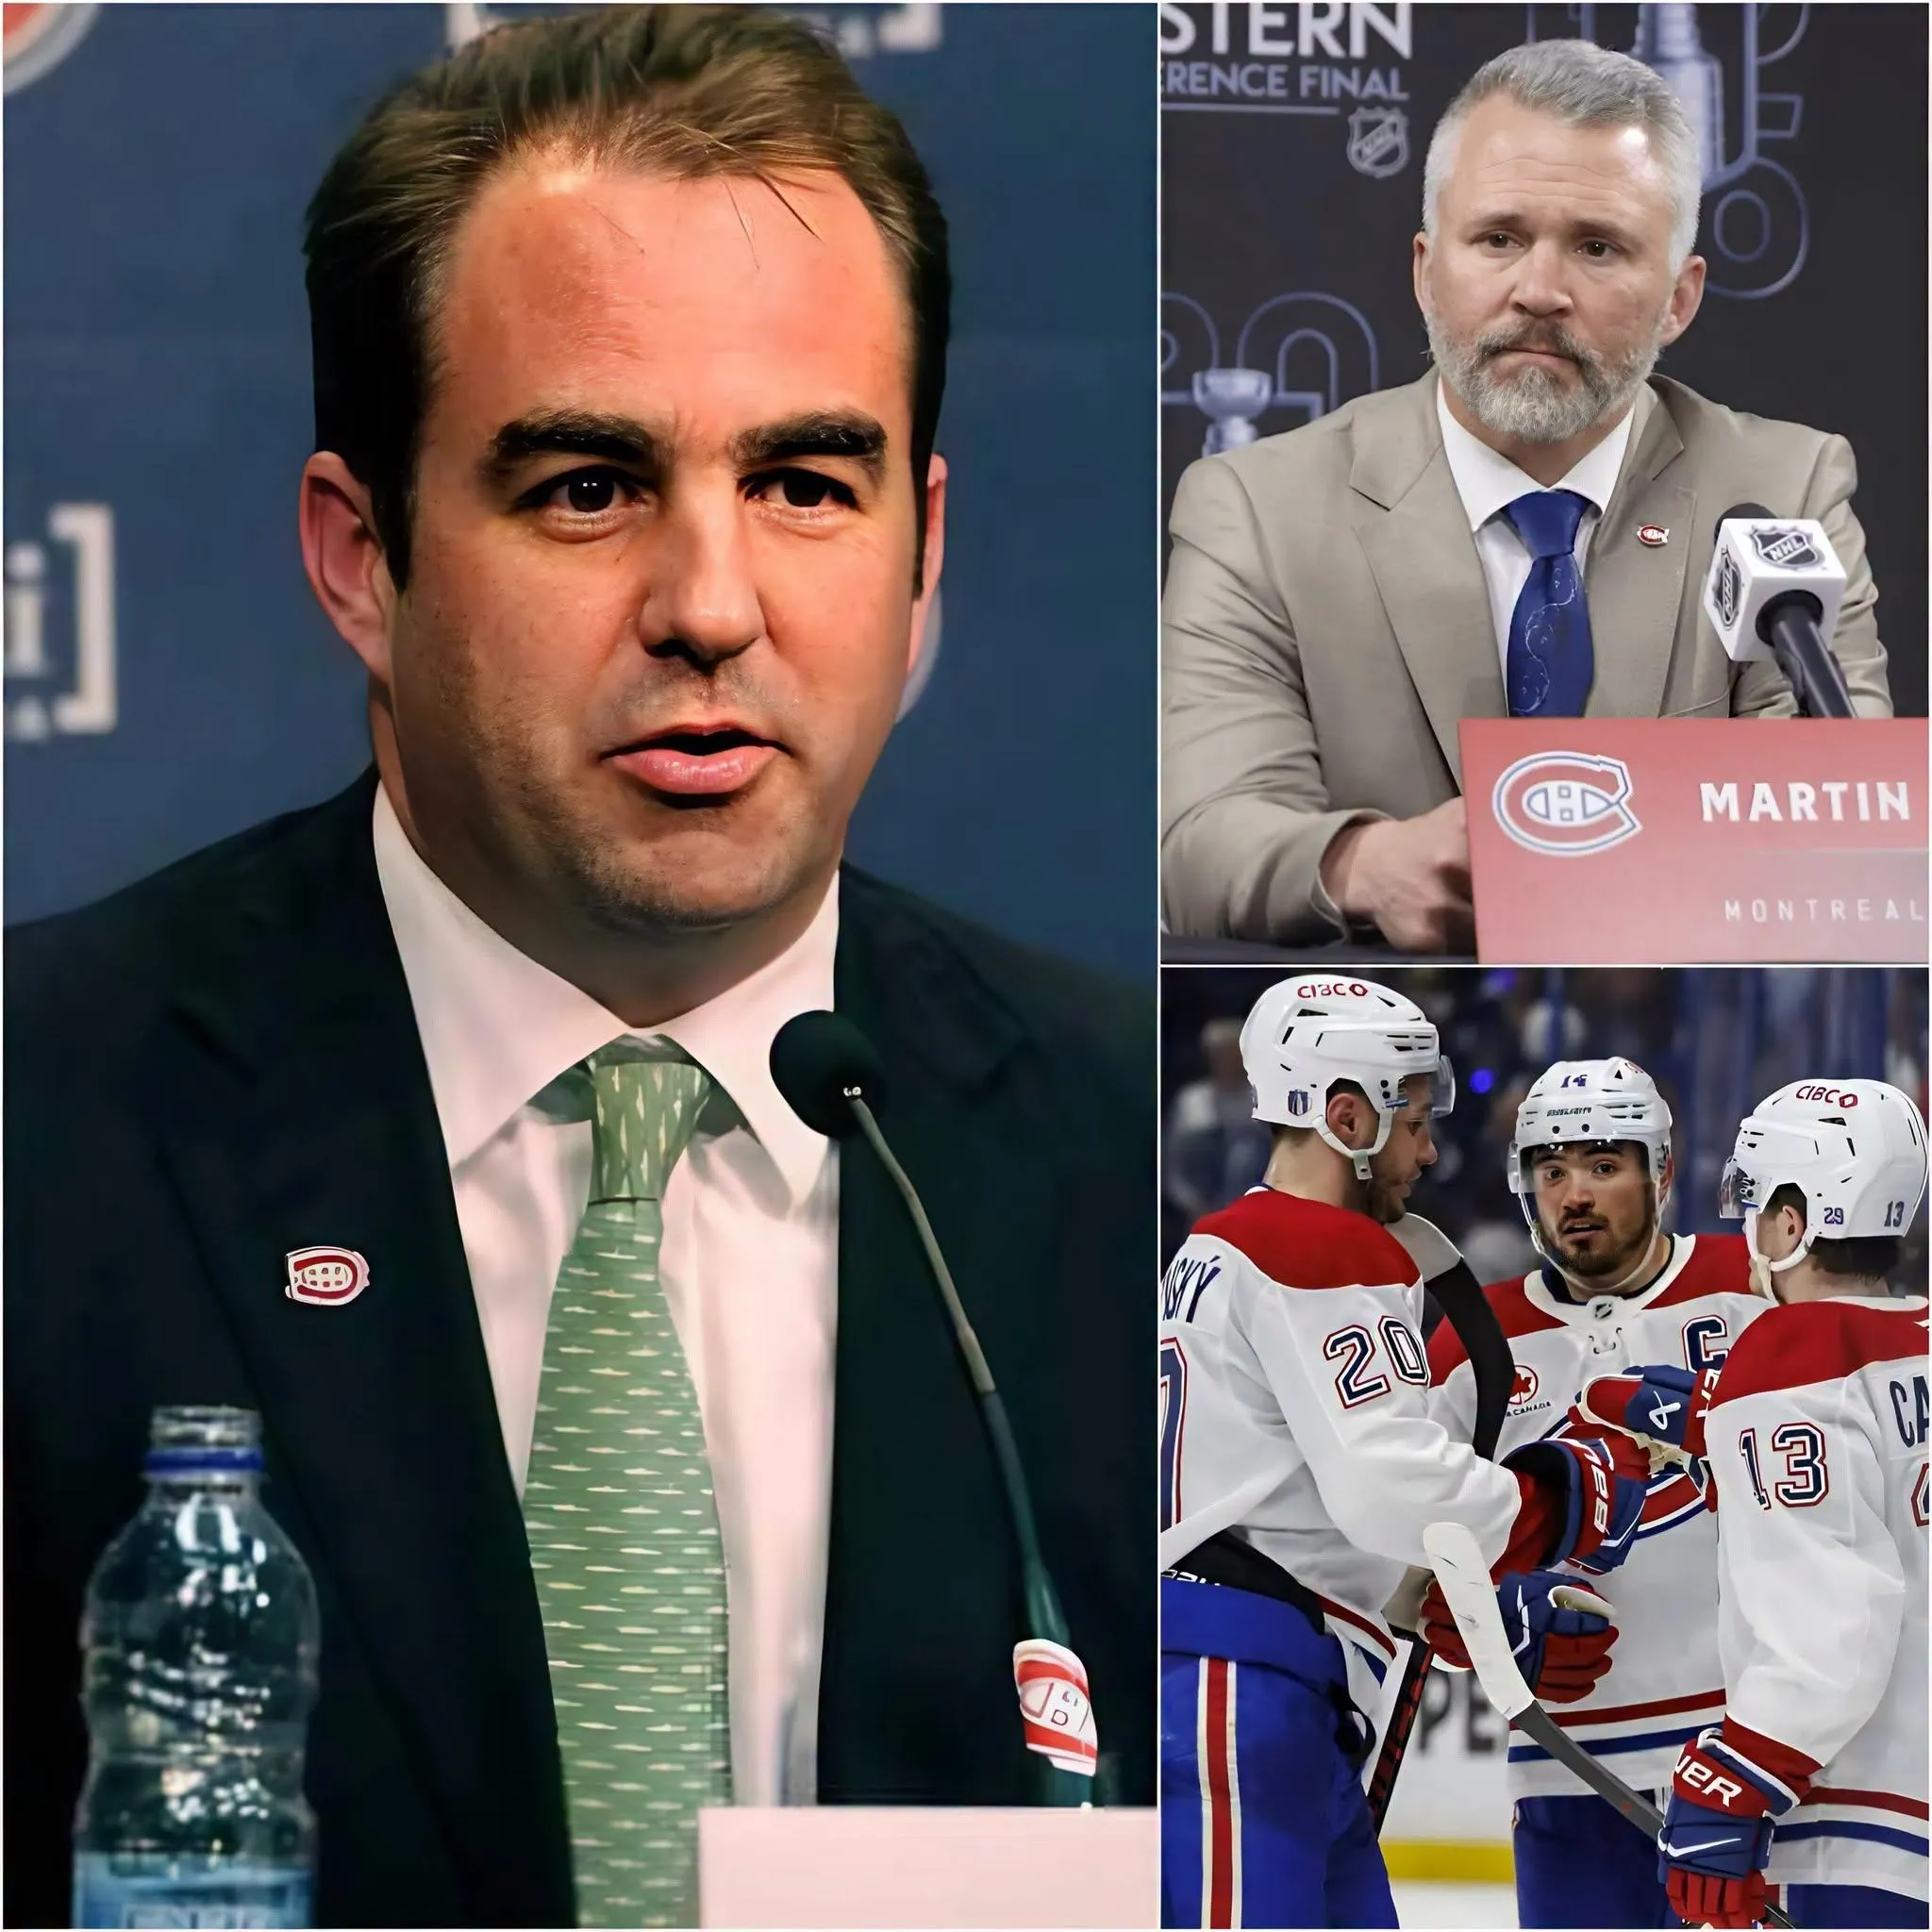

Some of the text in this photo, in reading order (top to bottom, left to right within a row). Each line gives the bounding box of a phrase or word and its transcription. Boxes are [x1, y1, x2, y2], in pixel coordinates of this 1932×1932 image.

[1161, 60, 1410, 102] RENCE FINAL
[1769, 534, 1806, 562] NHL
[1700, 782, 1911, 824] MARTIN
[1724, 897, 1924, 924] MONTREAL
[1884, 1200, 1906, 1227] 13
[1323, 1315, 1431, 1409] 20
[1682, 1314, 1729, 1374] C
[1739, 1422, 1829, 1511] 13
